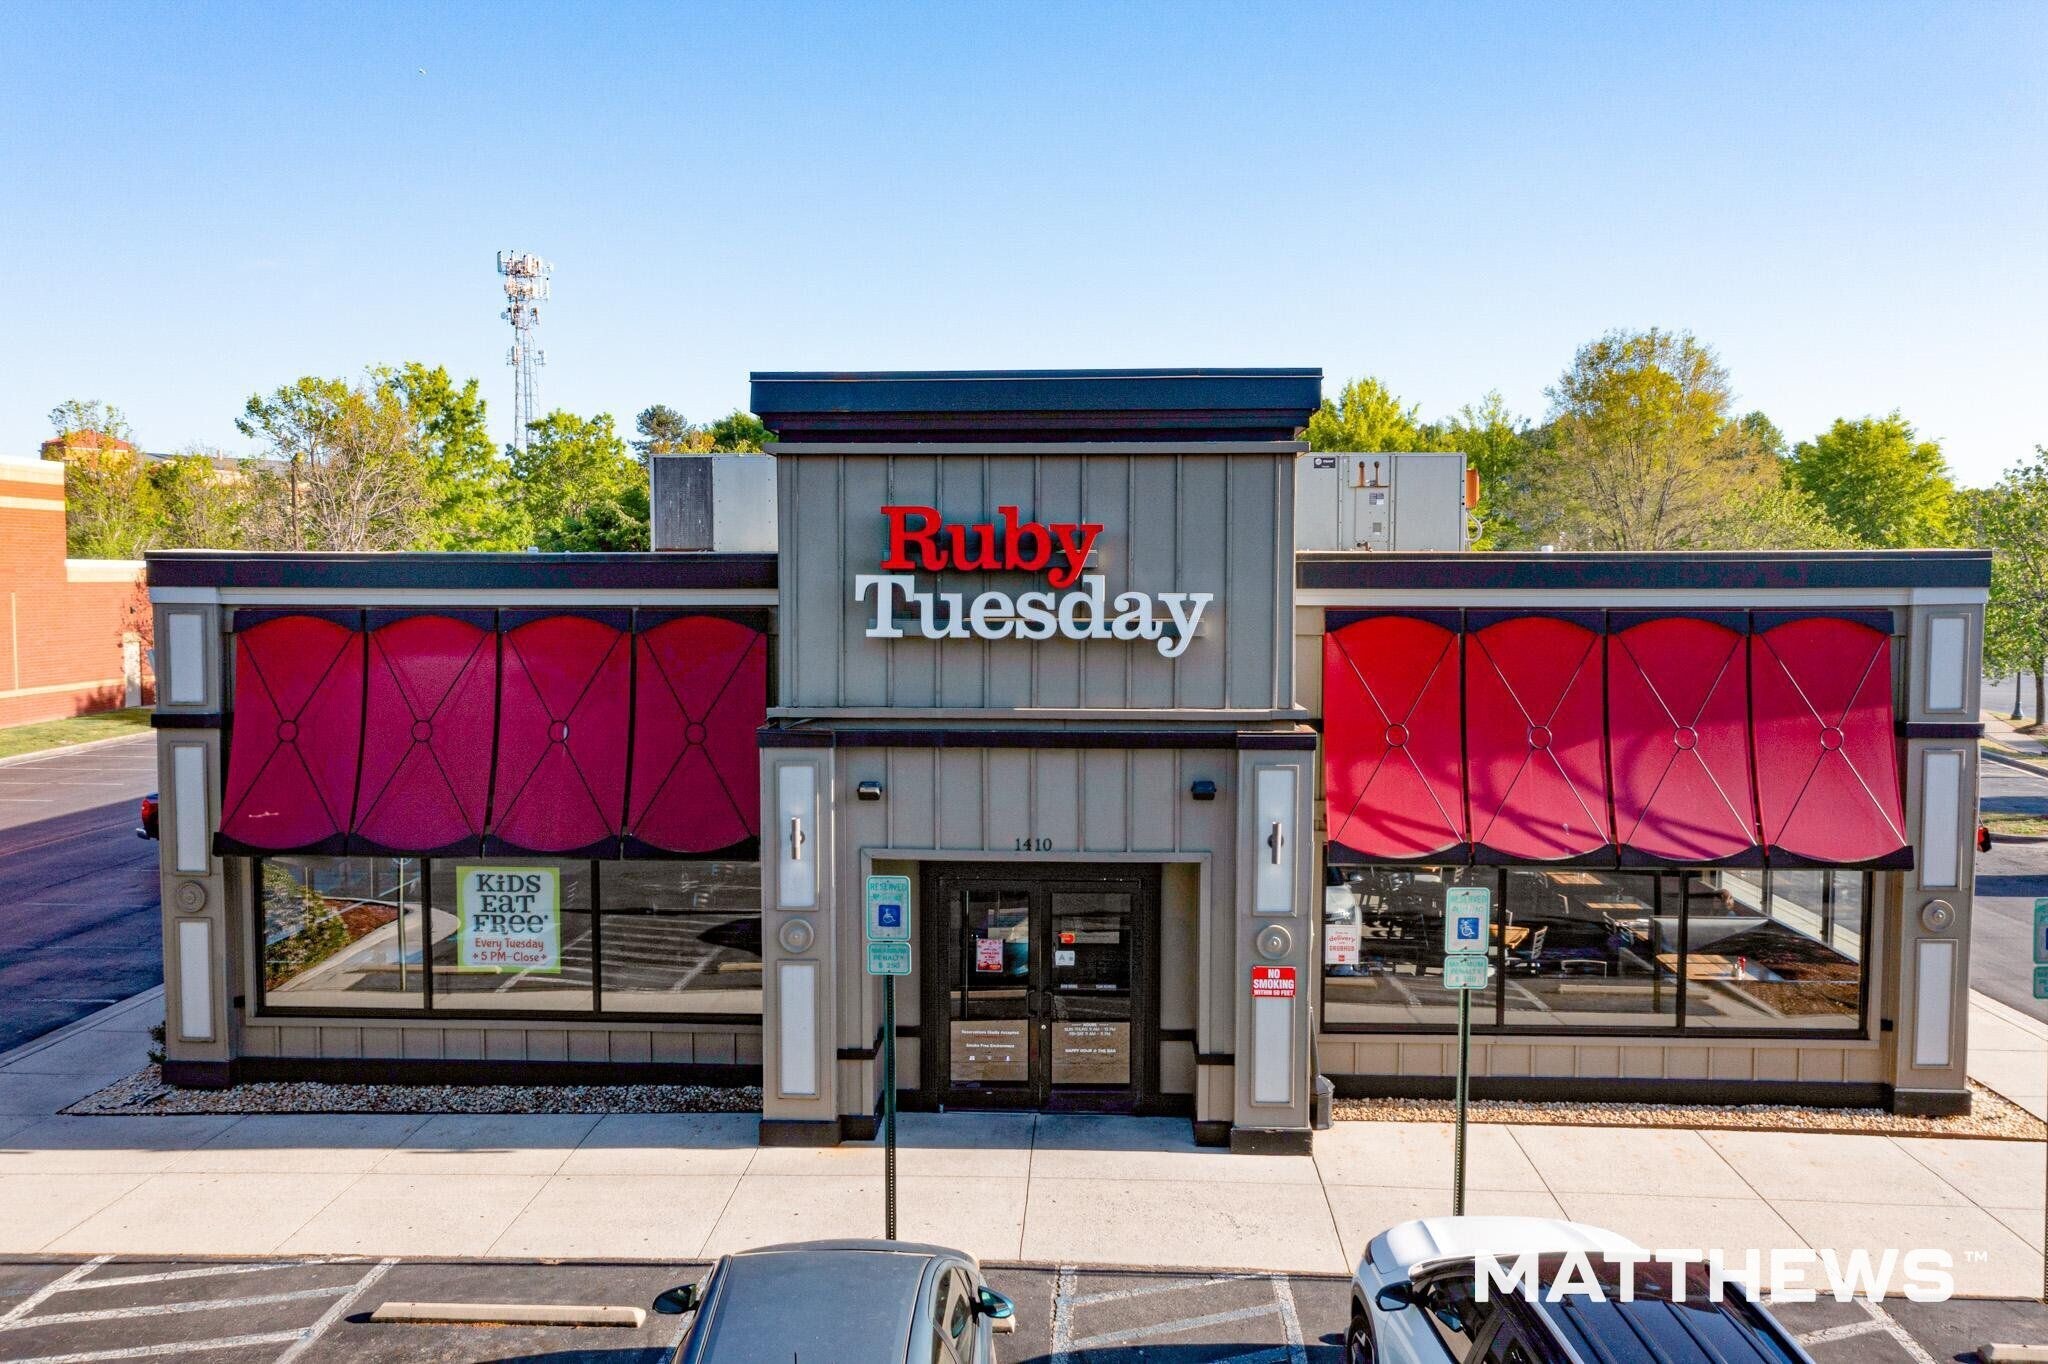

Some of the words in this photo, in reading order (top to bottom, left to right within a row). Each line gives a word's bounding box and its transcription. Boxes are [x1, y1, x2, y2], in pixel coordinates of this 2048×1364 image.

[880, 505, 1104, 588] Ruby
[855, 575, 1214, 657] Tuesday
[1015, 838, 1052, 851] 1410
[475, 938, 502, 952] Every
[505, 938, 544, 951] Tuesday
[1267, 968, 1280, 978] NO
[1253, 979, 1294, 989] SMOKING
